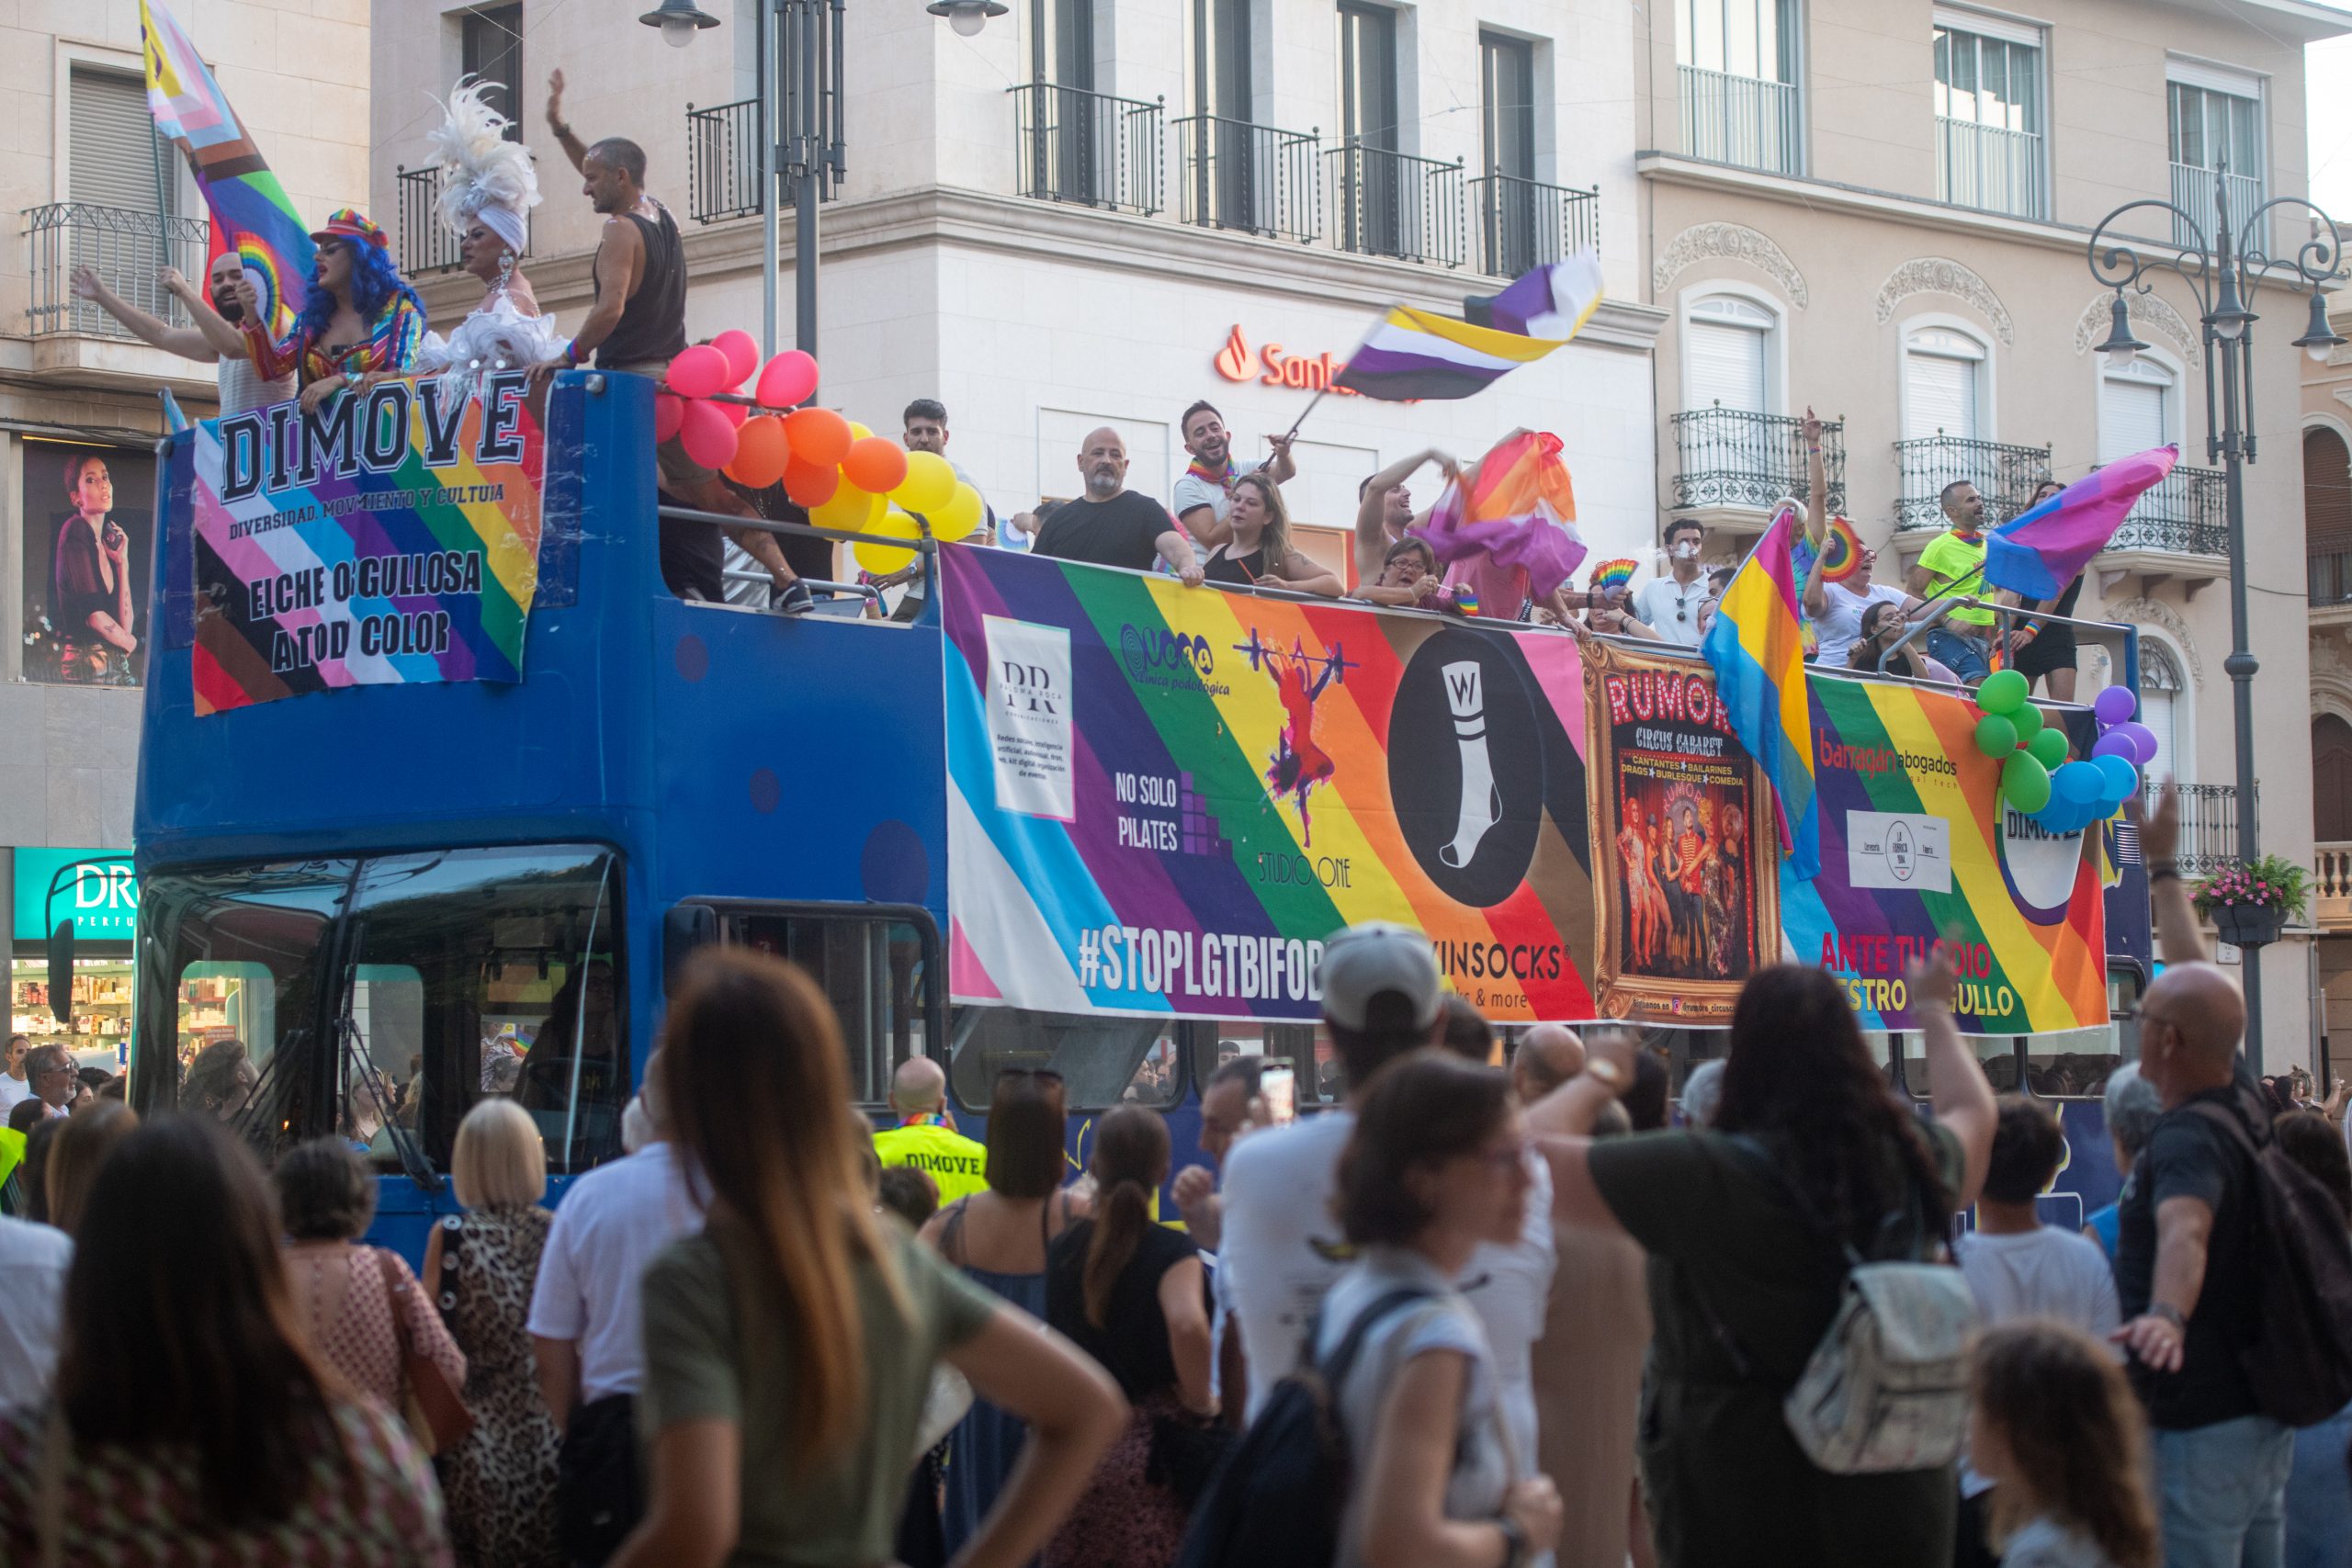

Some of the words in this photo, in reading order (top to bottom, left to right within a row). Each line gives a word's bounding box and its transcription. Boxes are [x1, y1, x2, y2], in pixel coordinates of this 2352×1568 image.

[1261, 343, 1365, 397] Sant
[220, 369, 531, 505] DIMOVE
[322, 490, 415, 518] MOVMIENTO
[419, 488, 434, 507] Y
[249, 567, 325, 621] ELCHE
[333, 550, 483, 603] OGULLOSA
[271, 630, 294, 673] A
[296, 619, 351, 669] TOD
[359, 610, 451, 657] COLOR
[1039, 690, 1062, 700] ROCA
[1449, 671, 1476, 708] W
[1605, 669, 1734, 738] RUMOR
[1635, 727, 1674, 751] CIRCUS
[1676, 731, 1724, 758] CABARET
[1622, 763, 1648, 777] DRAGS
[1656, 770, 1702, 784] BURLESQUE
[1709, 776, 1744, 786] COMEDIA
[1632, 756, 1680, 770] CANTANTES
[1687, 762, 1733, 775] BAILARINES
[1897, 750, 1957, 776] abogados
[1114, 772, 1136, 802] NO
[1139, 775, 1177, 808] SOLO
[1118, 816, 1178, 852] PILATES
[2007, 810, 2081, 840] DIM
[74, 864, 140, 908] DR
[1259, 852, 1313, 886] STUDIO
[1317, 856, 1351, 889] ONE
[1079, 923, 1330, 1001] #STOPLGTBIFOB
[1820, 932, 1888, 973] ANTE
[1895, 935, 1926, 973] TU
[1491, 993, 1528, 1009] more
[905, 1152, 980, 1176] DIMOVE
